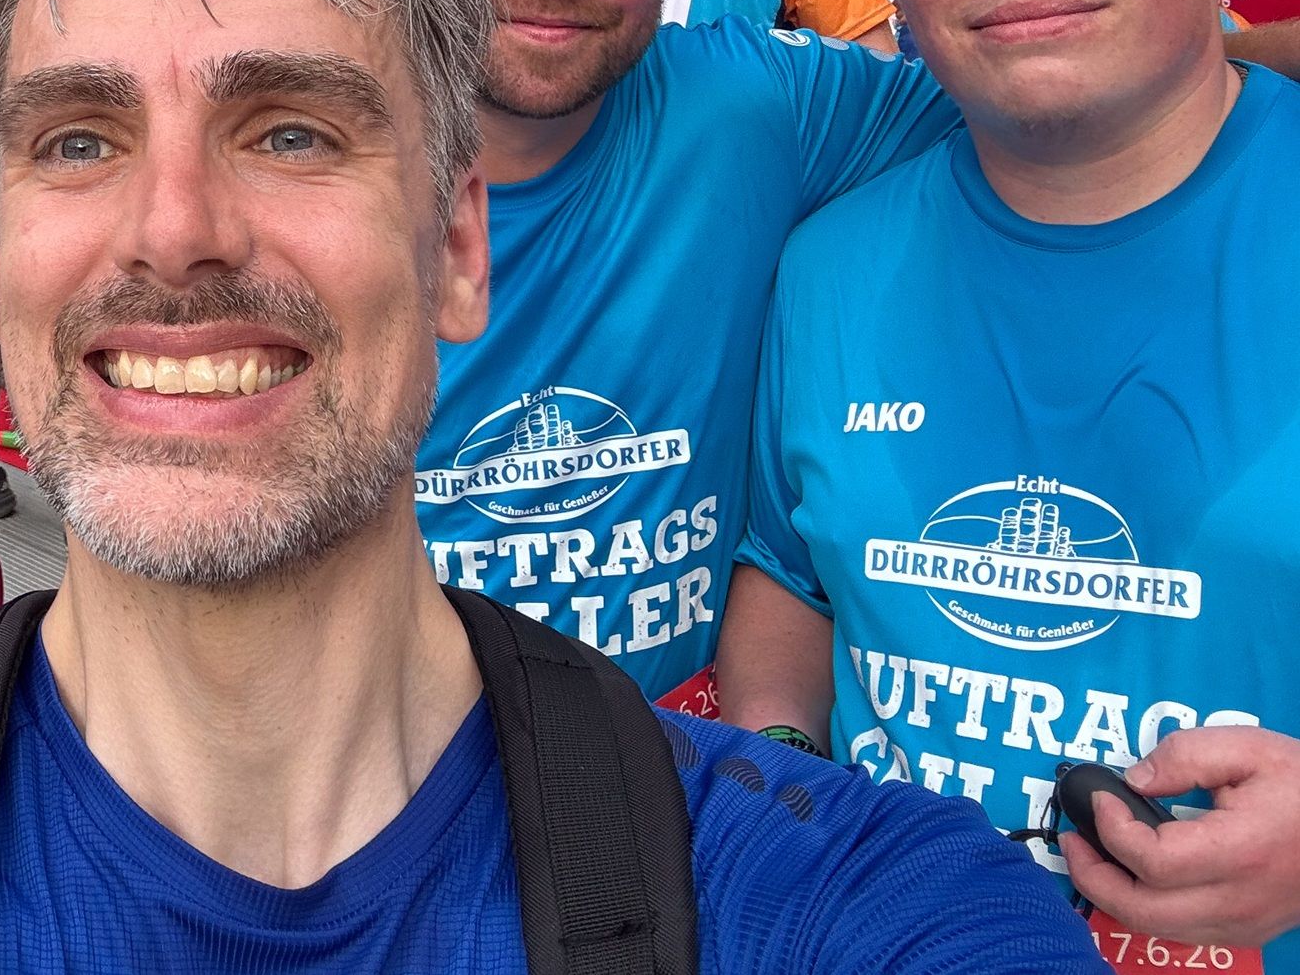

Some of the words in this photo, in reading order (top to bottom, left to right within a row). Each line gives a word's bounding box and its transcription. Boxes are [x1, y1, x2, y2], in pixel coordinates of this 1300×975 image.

[521, 385, 555, 407] Echt
[843, 401, 926, 433] JAKO
[1016, 474, 1060, 495] Echt
[488, 500, 541, 517] Geschmack
[544, 496, 560, 512] für
[562, 486, 609, 508] Genießer
[423, 495, 718, 590] UFTRAGS
[871, 544, 1190, 609] DÜRRRÖHRSDORFER
[947, 598, 1013, 637] Geschmack
[1015, 624, 1035, 639] für
[1037, 617, 1095, 639] Genießer
